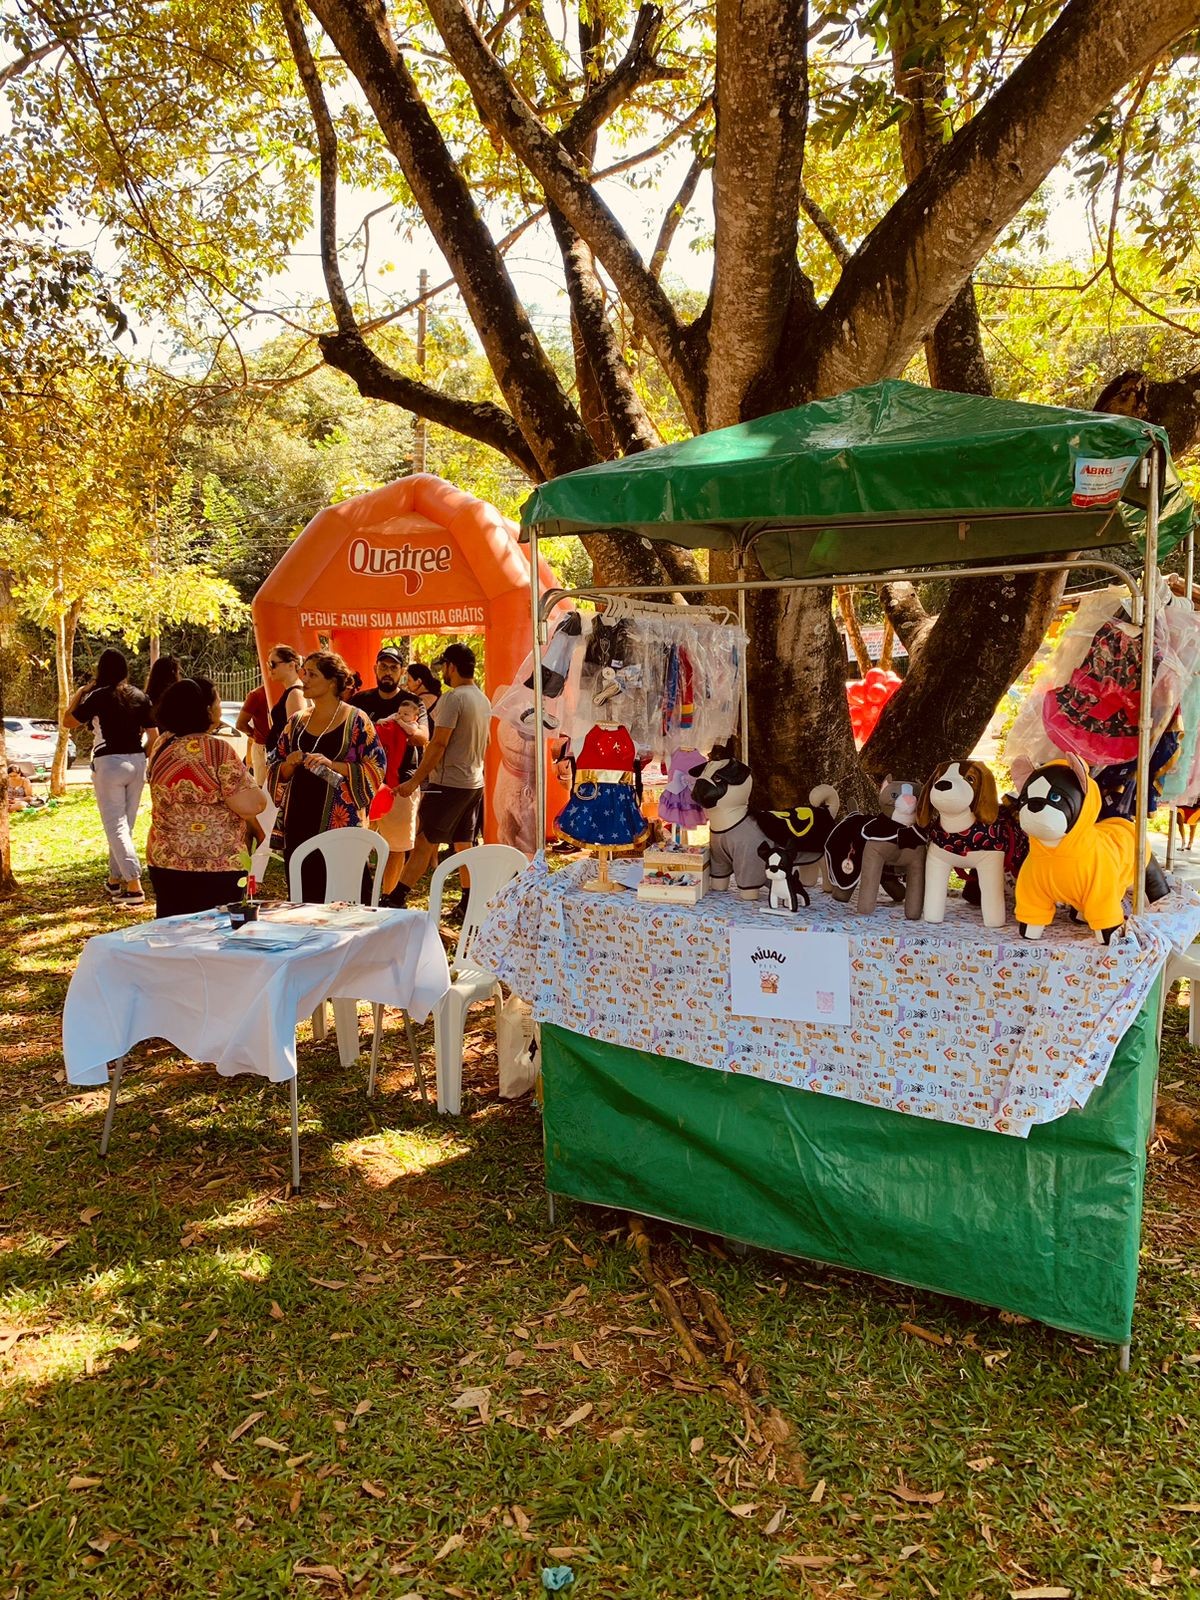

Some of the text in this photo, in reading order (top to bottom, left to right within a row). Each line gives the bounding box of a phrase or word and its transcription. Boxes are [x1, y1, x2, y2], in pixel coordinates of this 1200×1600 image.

[349, 538, 452, 595] Quatree
[301, 605, 484, 627] PEGUE AQUI SUA AMOSTRA GRÁTIS
